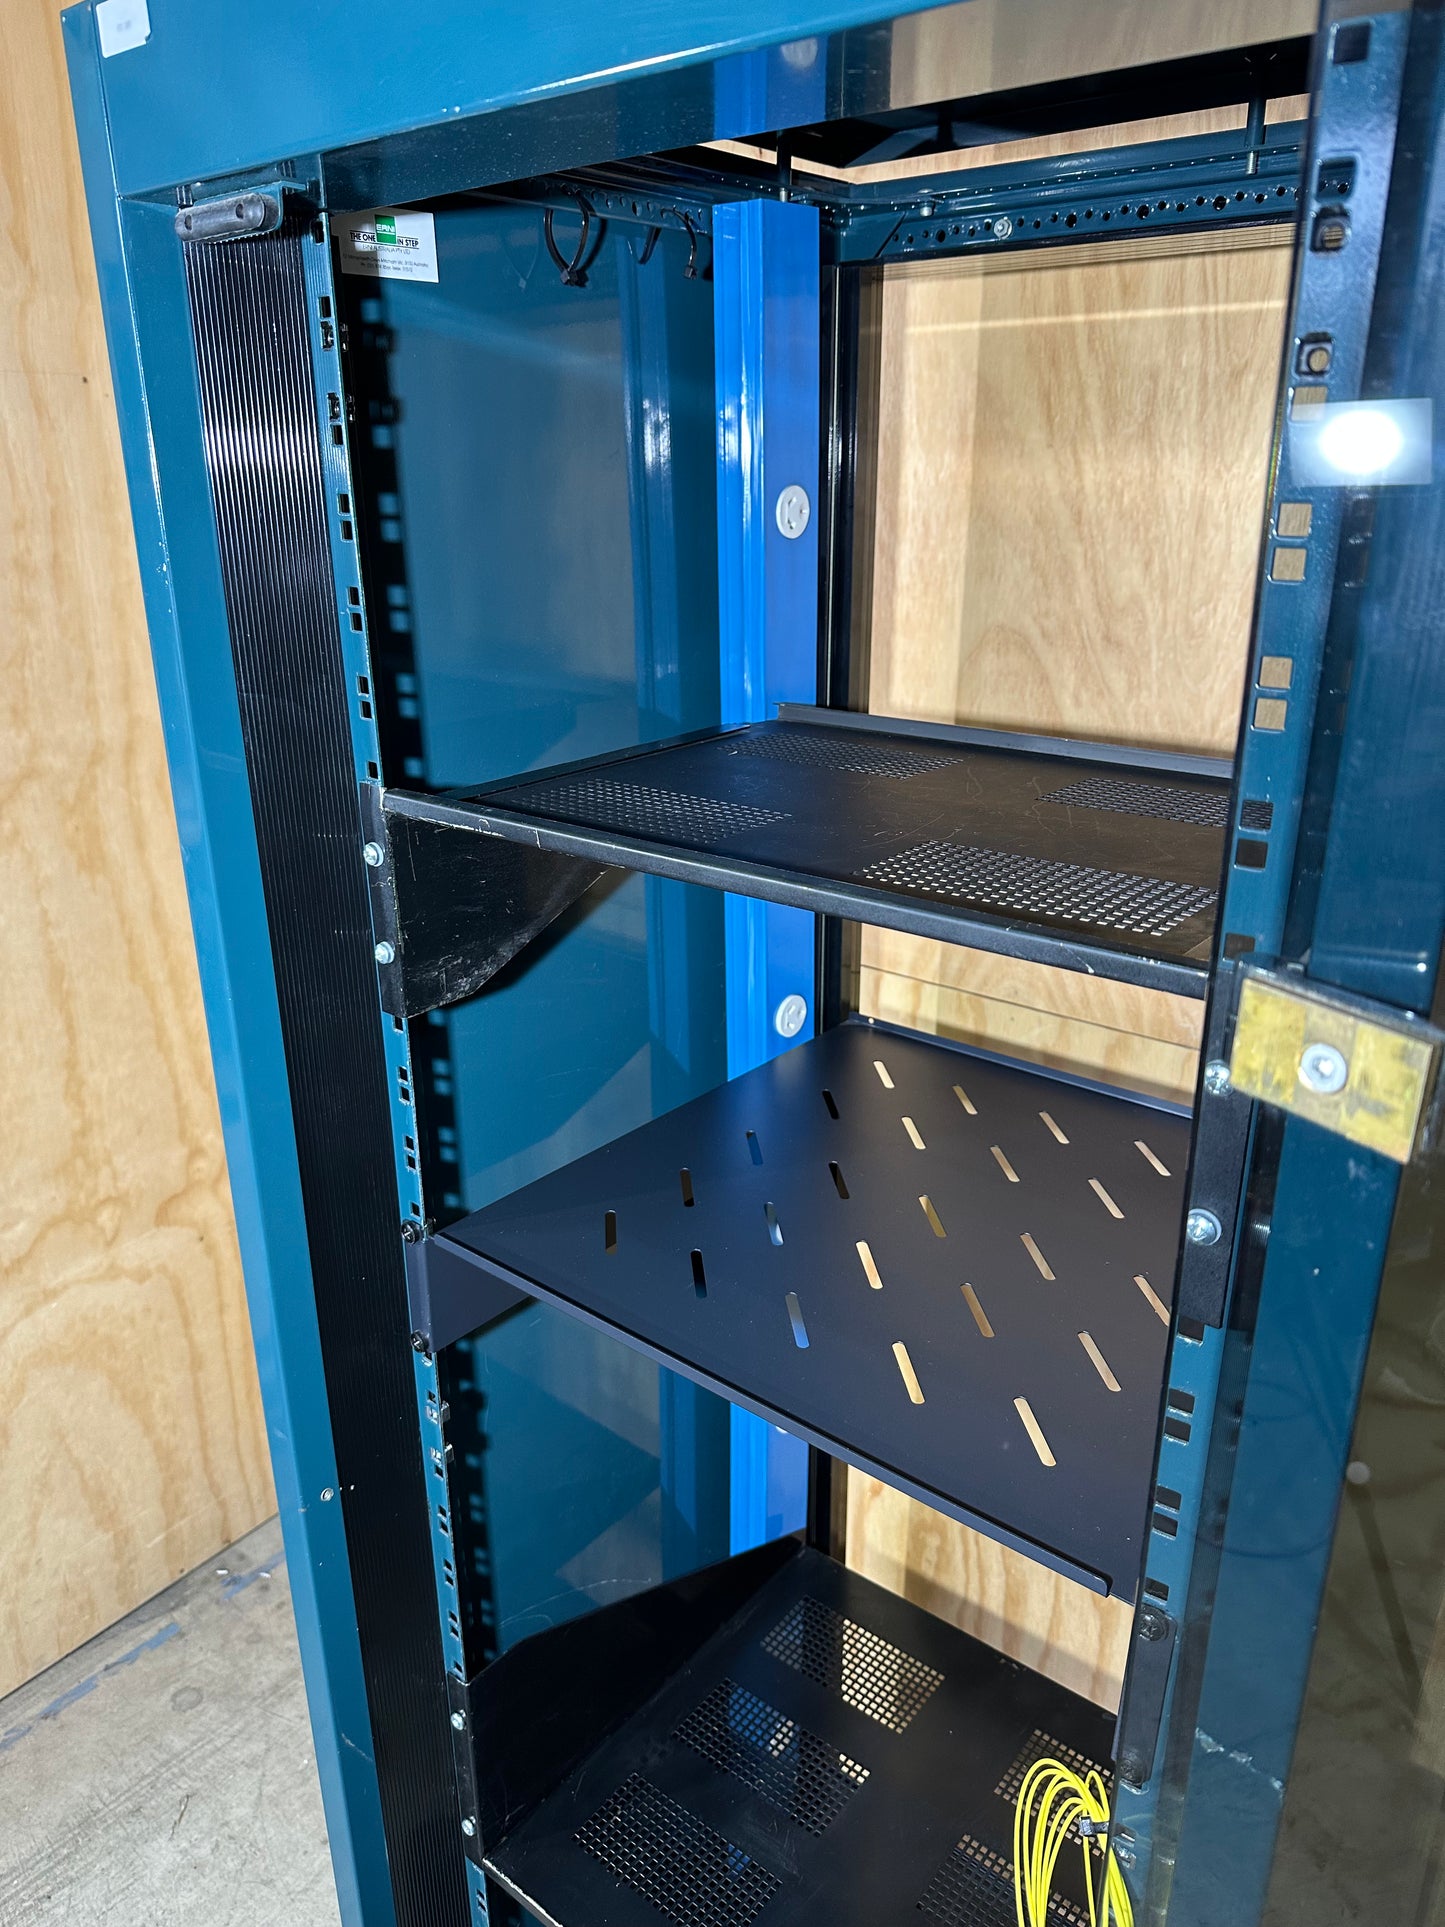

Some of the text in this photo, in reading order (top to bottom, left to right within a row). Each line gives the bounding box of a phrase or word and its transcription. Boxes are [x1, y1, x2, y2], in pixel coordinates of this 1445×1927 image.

[376, 223, 396, 233] ERNI
[350, 232, 362, 241] THE
[362, 233, 376, 242] ONE
[397, 238, 404, 246] IN
